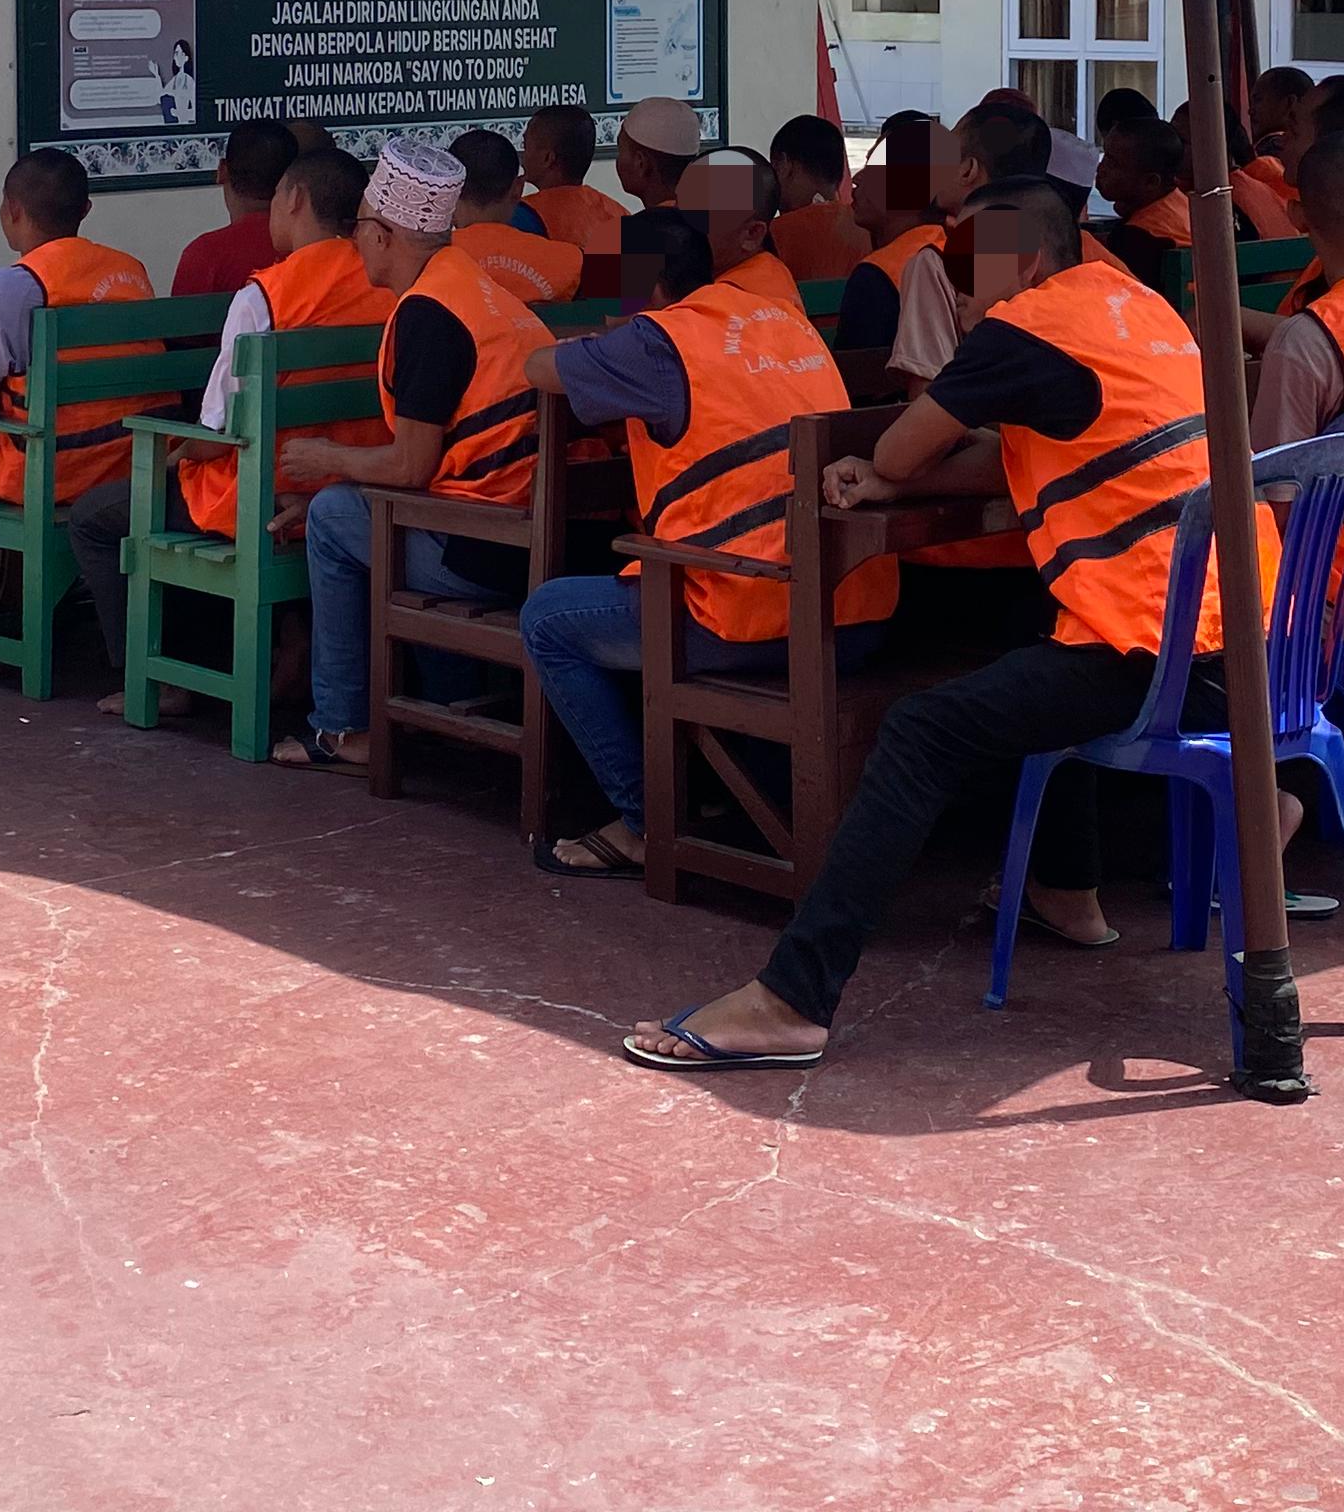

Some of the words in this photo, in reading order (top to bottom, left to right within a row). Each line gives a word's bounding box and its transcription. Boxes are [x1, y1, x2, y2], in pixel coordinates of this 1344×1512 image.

[272, 1, 345, 25] JAGALAH
[346, 0, 375, 24] DIRI
[377, 0, 408, 23] DAN
[410, 0, 500, 23] LINGKUNGAN
[251, 32, 315, 57] DENGAN
[317, 31, 385, 55] BERPOLA
[387, 29, 431, 53] HIDUP
[433, 28, 481, 52] BERSIH
[483, 28, 513, 50] DAN
[514, 26, 558, 49] SEHAT
[284, 63, 330, 87] JAUHI
[332, 60, 404, 85] NARKOBA
[406, 59, 440, 83] "SAY
[442, 58, 464, 82] NO
[465, 57, 485, 81] TO
[486, 56, 529, 80] DRUG"
[215, 96, 284, 122] TINGKAT
[285, 92, 366, 119] KEIMANAN
[368, 90, 425, 115] KEPADA
[427, 88, 476, 112] TUHAN
[478, 86, 517, 110] YANG
[518, 84, 559, 107] MAHA
[561, 83, 587, 106] ESA
